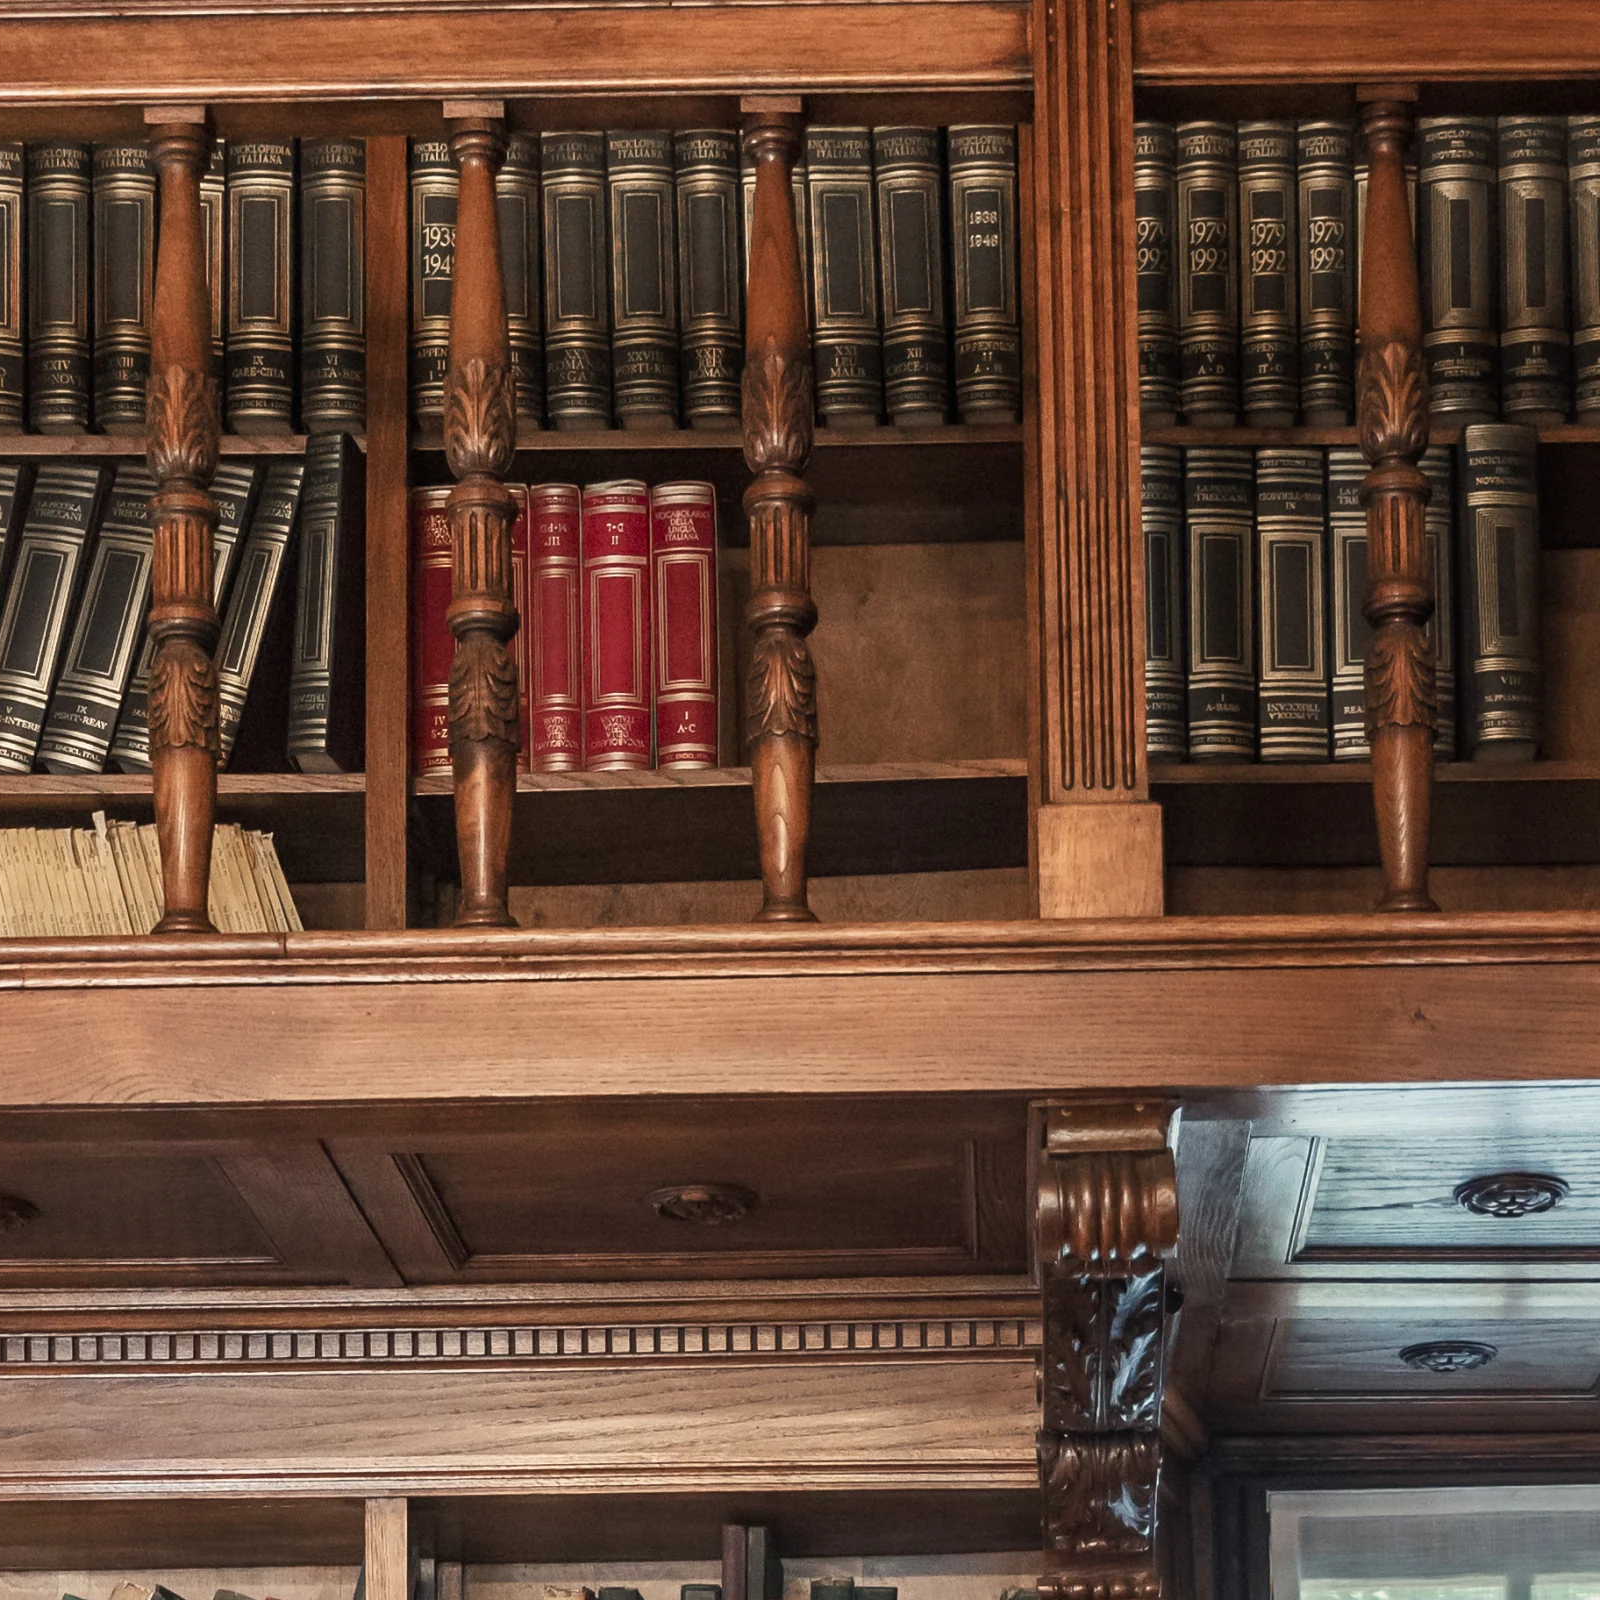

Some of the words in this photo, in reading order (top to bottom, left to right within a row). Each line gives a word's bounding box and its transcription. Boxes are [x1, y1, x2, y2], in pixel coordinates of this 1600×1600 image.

[1189, 221, 1227, 245] 1979
[1251, 223, 1286, 247] 1979
[1309, 221, 1345, 244] 1979
[422, 253, 455, 275] 194
[1189, 248, 1228, 271] 1992
[1251, 249, 1286, 273] 1992
[1309, 247, 1345, 271] 1992
[252, 355, 264, 366] IX
[906, 347, 923, 359] XII
[5, 706, 13, 715] V
[76, 704, 88, 715] IX
[433, 715, 446, 726] IV
